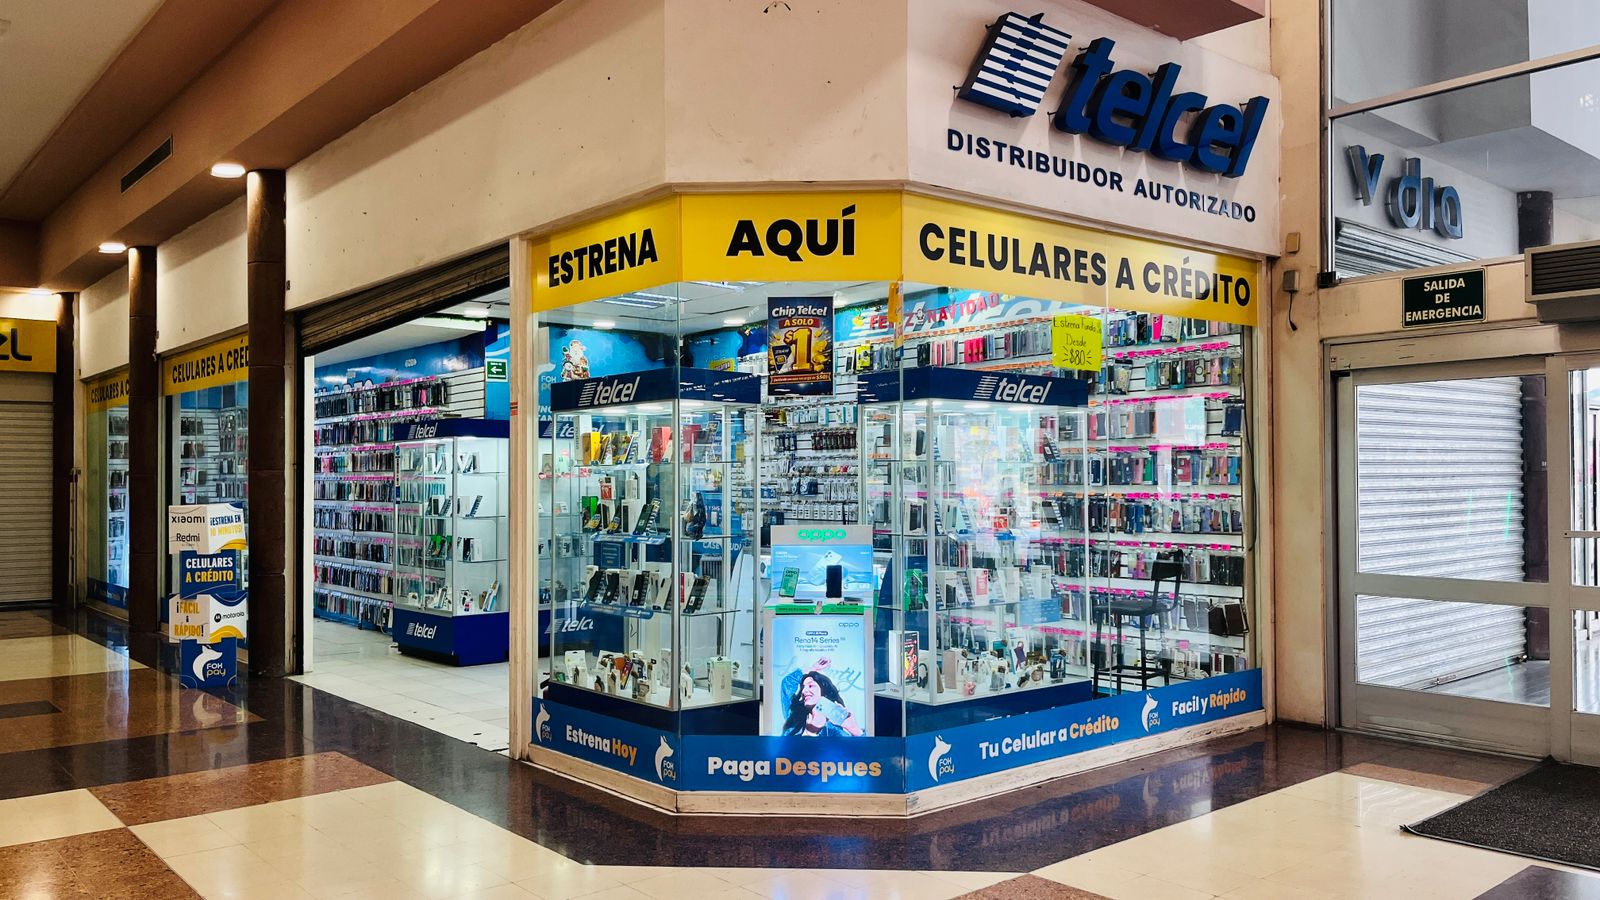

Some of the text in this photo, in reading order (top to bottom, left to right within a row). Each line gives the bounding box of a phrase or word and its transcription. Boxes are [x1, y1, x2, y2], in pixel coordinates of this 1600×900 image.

[1054, 36, 1270, 179] telcel
[947, 128, 1257, 223] DISTRIBUIDOR AUTORIZADO
[725, 203, 857, 263] AQUÍ
[547, 227, 659, 288] ESTRENA
[919, 222, 1251, 307] CELULARES A CRÉDITO
[1423, 277, 1466, 292] SALIDA
[1435, 292, 1450, 304] DE
[771, 305, 828, 318] Chip Telcel
[1405, 304, 1482, 322] EMERGENCIA
[783, 318, 814, 327] A SOLO
[172, 355, 217, 384] CELULARES
[218, 352, 225, 374] A
[90, 382, 119, 404] CELULARES
[593, 376, 641, 405] telcel
[994, 377, 1053, 403] telcel
[415, 422, 439, 439] telcel
[171, 515, 206, 524] xiaomi
[176, 533, 201, 542] Redmi
[797, 528, 847, 542] oppo
[185, 557, 234, 569] CELULARES
[185, 568, 234, 583] A CRÉDITO
[222, 611, 245, 619] motorola
[174, 621, 204, 637] RÁPIDO!
[413, 621, 437, 639] telcel
[206, 669, 226, 678] pay
[1172, 687, 1247, 716] Facil y Rápido
[565, 724, 638, 766] Estrena Hoy
[979, 714, 1120, 760] Tu Celular a Crédito
[663, 769, 677, 780] pay
[707, 756, 882, 783] Paga Despues
[938, 764, 955, 777] pay
